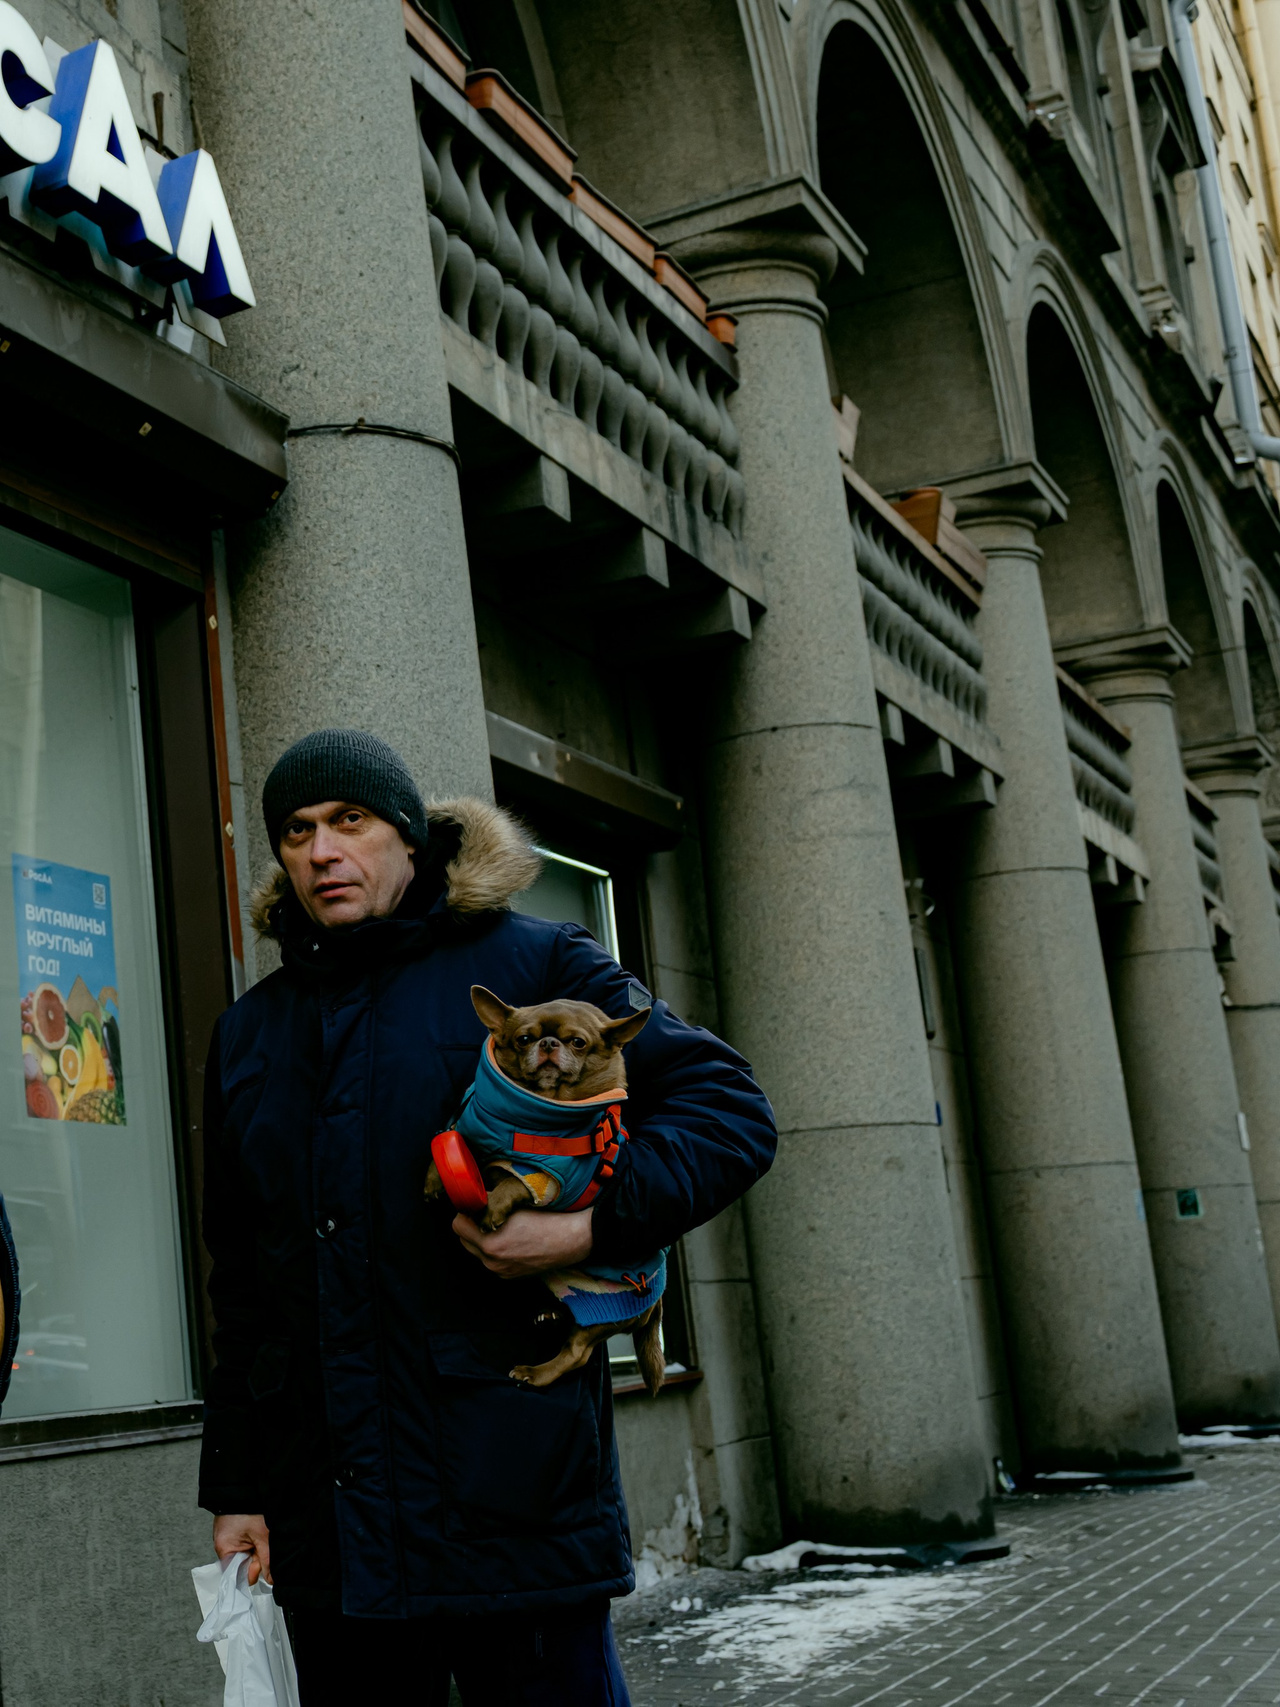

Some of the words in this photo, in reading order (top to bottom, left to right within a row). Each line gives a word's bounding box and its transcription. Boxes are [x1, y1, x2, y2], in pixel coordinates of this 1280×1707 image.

[25, 903, 106, 936] ВИТАМИНЫ
[26, 929, 94, 958] КРУГЛЫЙ
[28, 955, 60, 976] ГОД!
